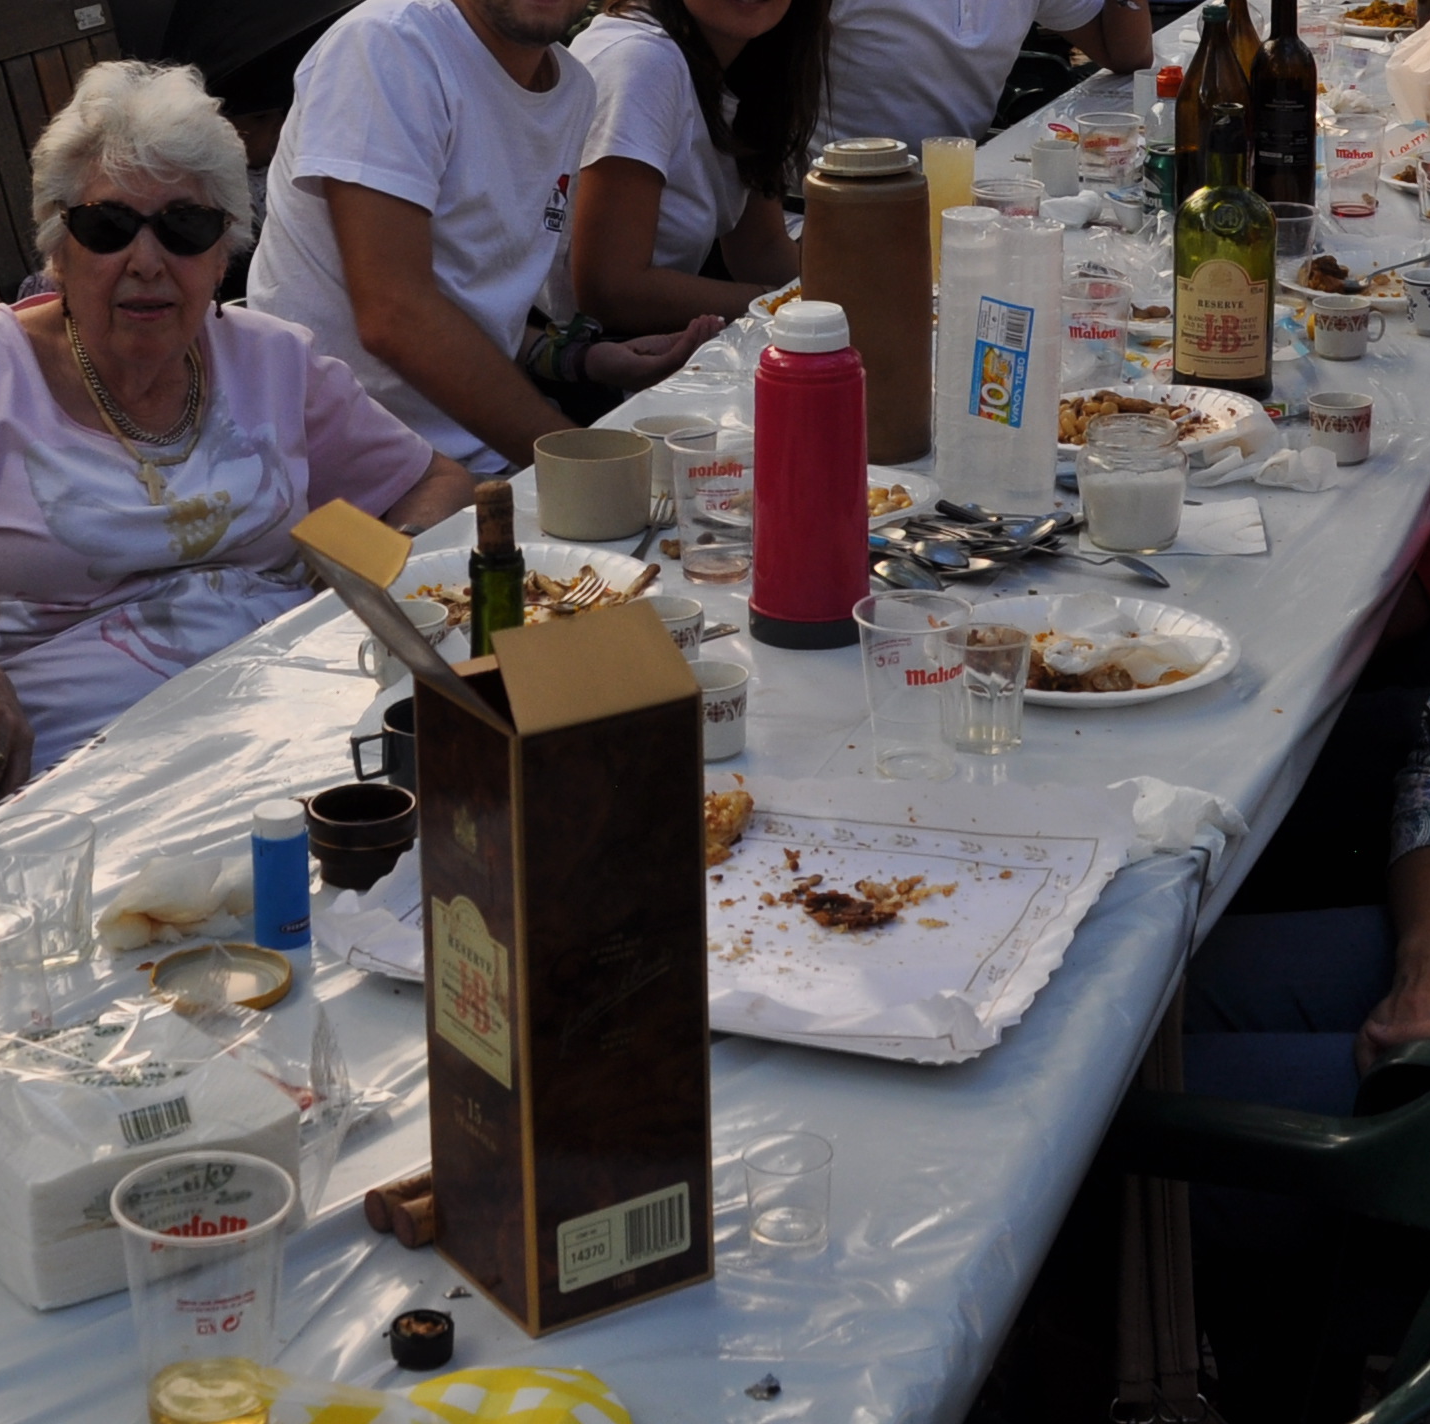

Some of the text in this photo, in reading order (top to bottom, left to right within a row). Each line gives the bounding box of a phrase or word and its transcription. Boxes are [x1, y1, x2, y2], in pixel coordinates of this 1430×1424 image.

[1335, 148, 1374, 159] Mahou
[1389, 132, 1428, 159] LOLITA
[1197, 299, 1244, 309] RESERVE
[1068, 325, 1118, 340] Mahou
[1196, 313, 1242, 353] J&B
[1015, 357, 1026, 385] TUBO
[981, 382, 1010, 418] 10
[905, 663, 963, 686] Mahou
[448, 934, 493, 975] RESERVE
[571, 1242, 606, 1265] 14370
